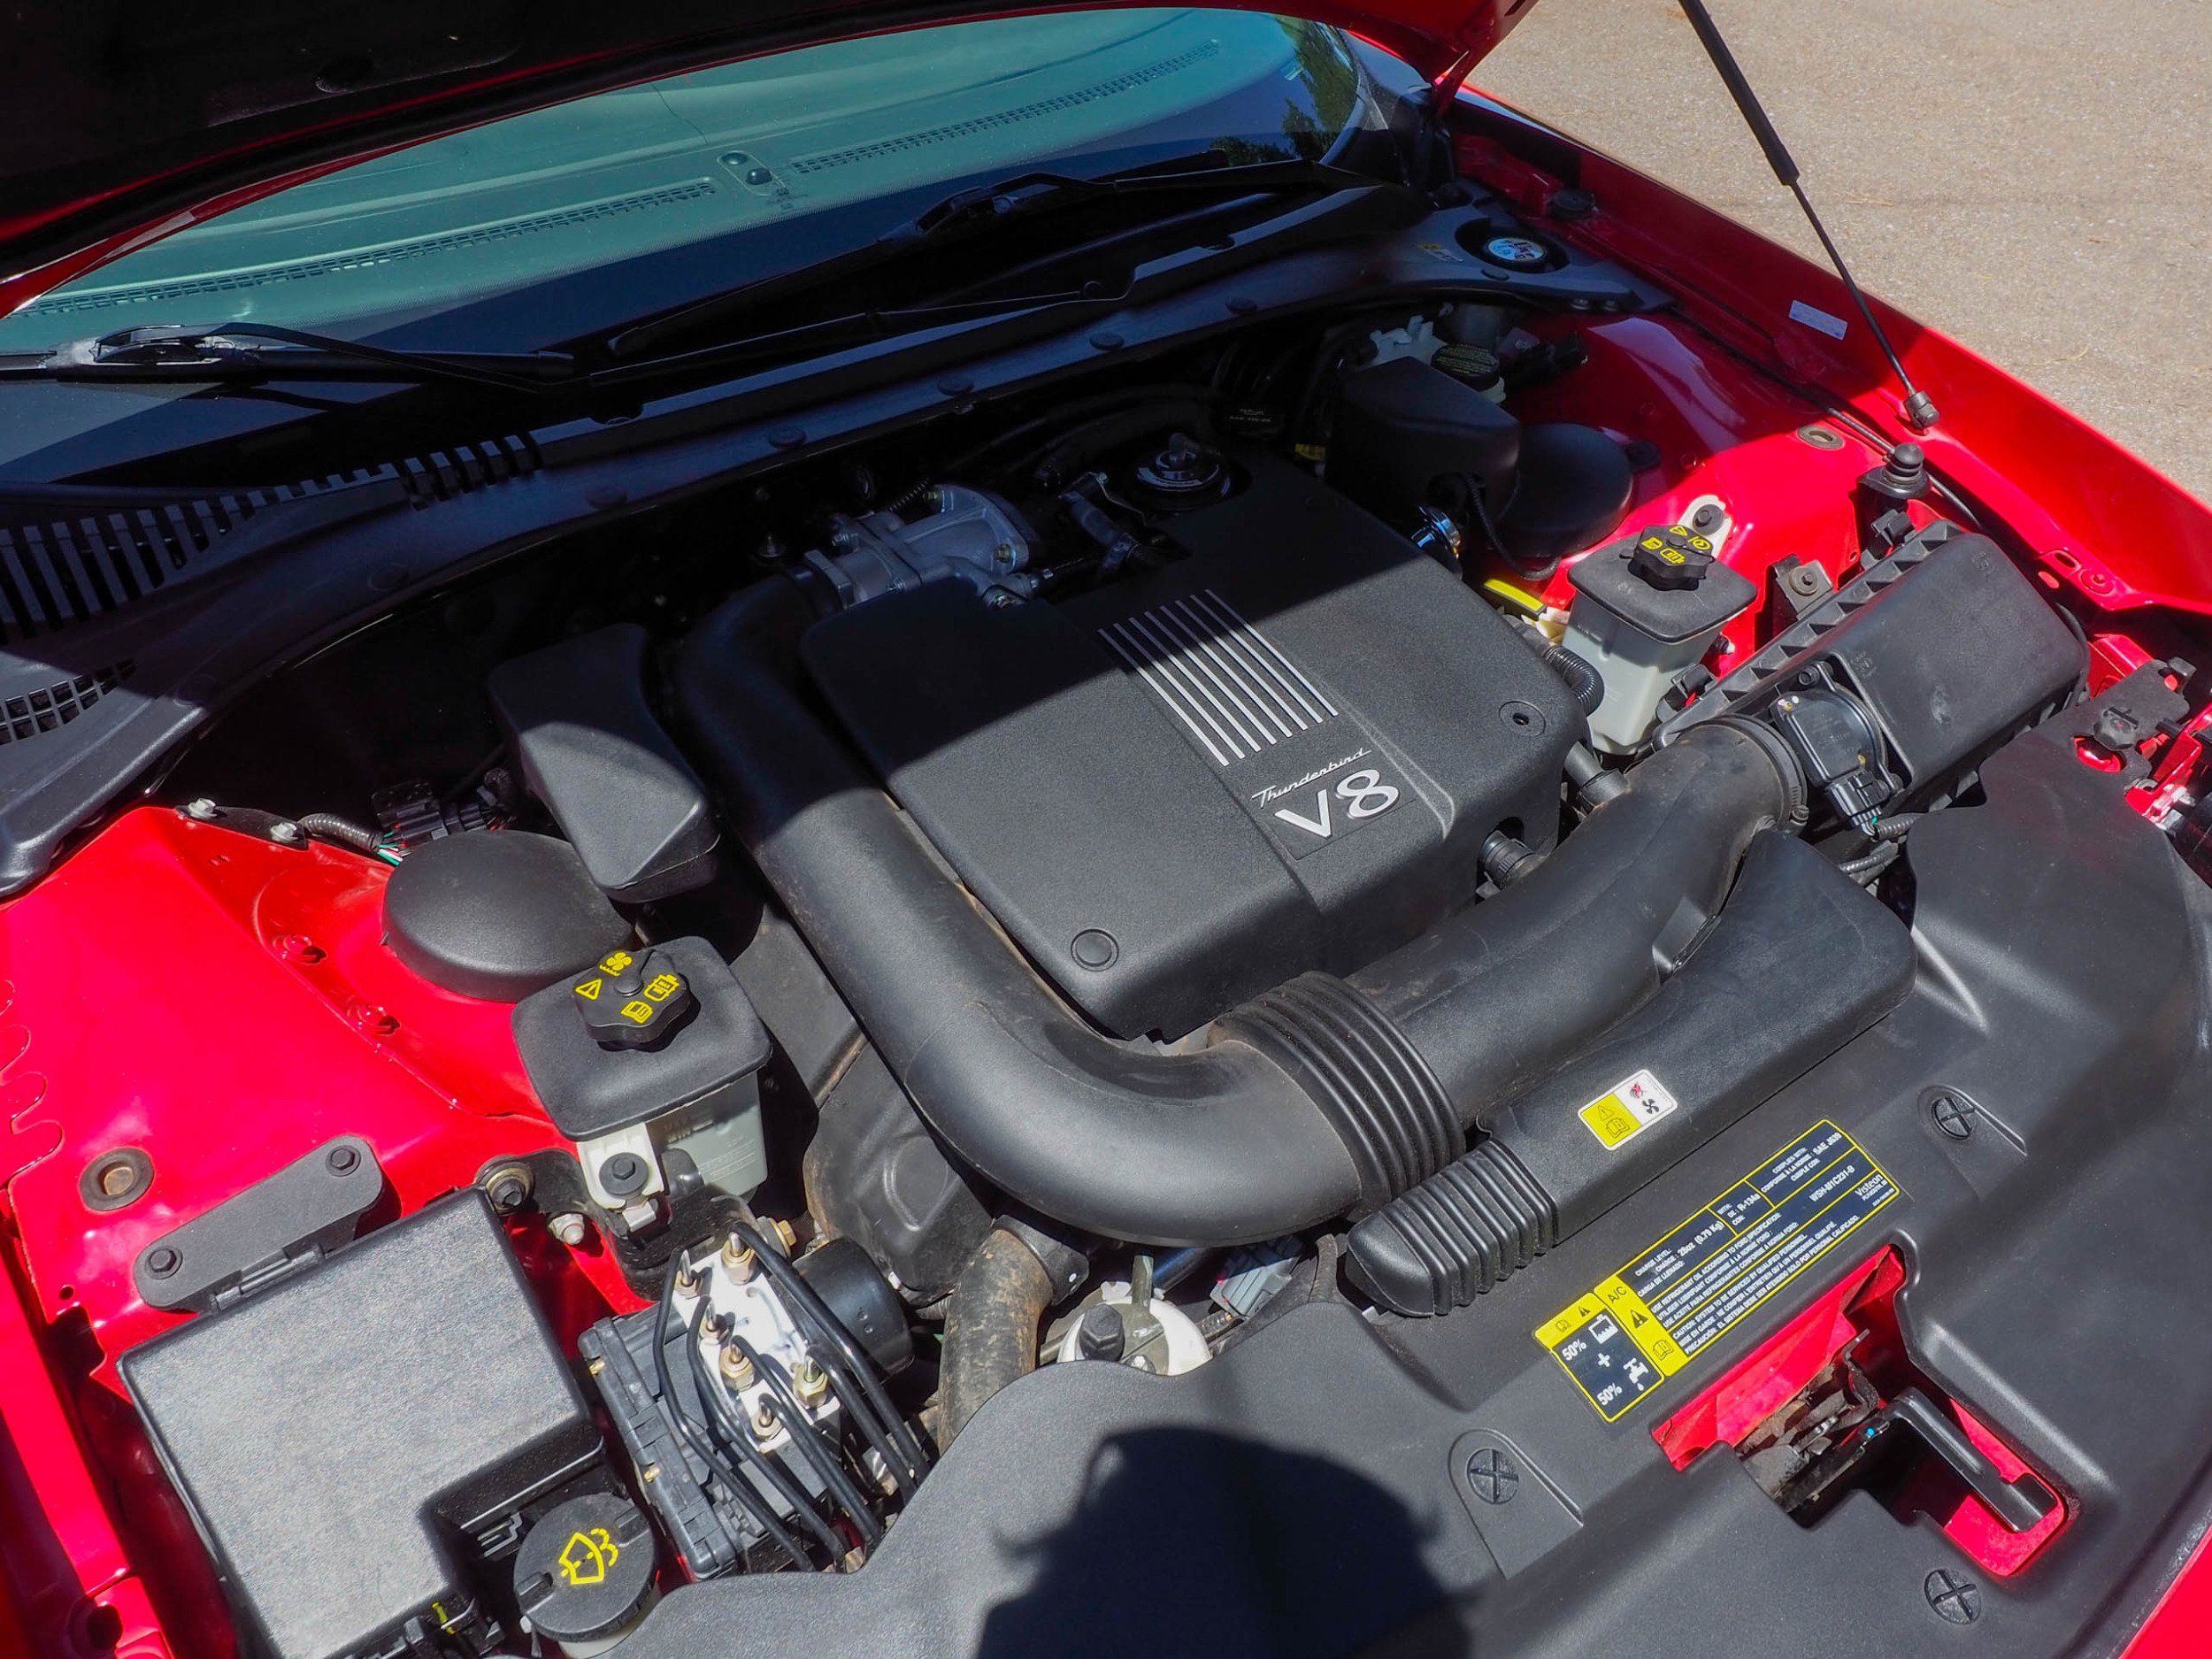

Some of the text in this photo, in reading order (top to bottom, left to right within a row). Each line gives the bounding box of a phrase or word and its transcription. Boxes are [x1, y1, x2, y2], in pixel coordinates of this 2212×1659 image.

[1250, 747, 1372, 809] Thunderbird
[1274, 769, 1400, 839] V8
[1813, 1143, 1828, 1155] SAE
[1826, 1133, 1842, 1145] J639
[1772, 1156, 1795, 1174] COMPLIES
[1855, 1174, 1883, 1196] Visteon
[1737, 1193, 1761, 1211] R-134a
[1635, 1248, 1672, 1277] CHARGE LEVEL:
[1655, 1256, 1676, 1272] CHARGE
[1709, 1220, 1724, 1233] Kg)
[1650, 1302, 1663, 1313] USE
[1661, 1278, 1694, 1305] REFRIGERANT
[1701, 1252, 1729, 1274] ACCORDING
[1734, 1237, 1748, 1249] FORD
[1663, 1317, 1675, 1327] USE
[1673, 1304, 1692, 1319] ACEITE
[1689, 1294, 1704, 1307] PARA
[1701, 1266, 1740, 1297] REFRIGERANTES
[1739, 1248, 1765, 1269] CONFORME
[1767, 1233, 1786, 1247] NORMA
[1672, 1319, 1696, 1339] CAUTION:
[1694, 1304, 1715, 1322] SYSTEM
[1727, 1277, 1751, 1296] SERVICED
[1756, 1254, 1781, 1274] QUALIFIED
[1779, 1233, 1808, 1256] PERSONNEL.
[1678, 1281, 1706, 1304] LUBRIFIANT
[1704, 1262, 1732, 1284] CONFORME
[1740, 1241, 1758, 1256] NORME
[1755, 1232, 1770, 1244] FORD
[1697, 1316, 1716, 1332] GARDE
[1724, 1293, 1746, 1311] CONFIER
[1789, 1238, 1816, 1260] PERSONNEL
[1724, 1304, 1745, 1323] SISTEMA
[1755, 1287, 1768, 1298] SER
[1765, 1271, 1789, 1290] ATENDIDO
[1786, 1261, 1801, 1273] SOLO
[1799, 1253, 1811, 1263] POR
[1809, 1235, 1833, 1256] PERSONAL
[1832, 1215, 1860, 1238] CALIFICADO.
[1607, 1286, 1627, 1303] A/C
[1637, 1282, 1655, 1297] CARGA
[1561, 1337, 1587, 1363] 50%
[1596, 1381, 1624, 1407] 50%
